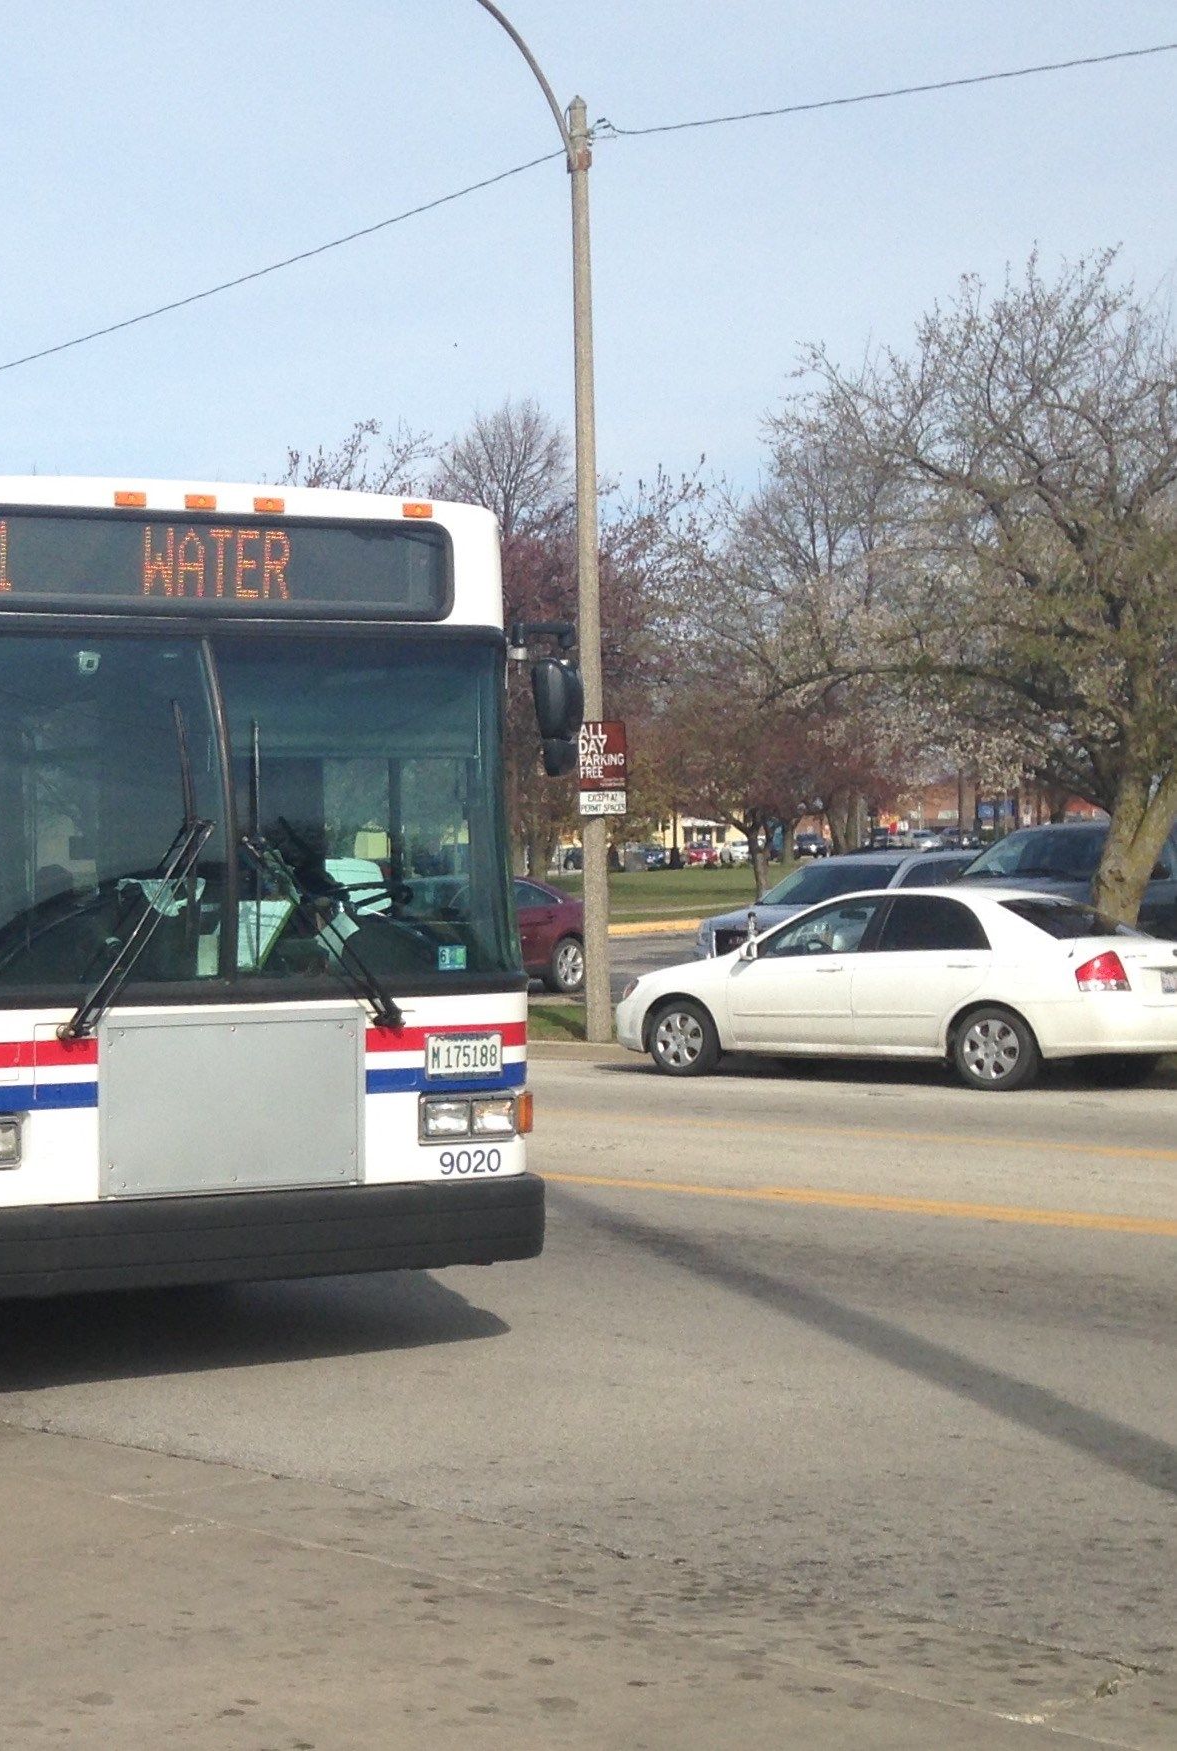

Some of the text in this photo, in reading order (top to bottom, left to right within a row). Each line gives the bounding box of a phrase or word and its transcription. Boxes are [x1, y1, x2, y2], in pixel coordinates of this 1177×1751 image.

[143, 525, 291, 600] WATER
[579, 723, 608, 739] ALL
[578, 738, 608, 754] DAY
[579, 753, 625, 767] PARKING
[579, 766, 604, 779] FREE
[439, 1148, 502, 1176] 9020
